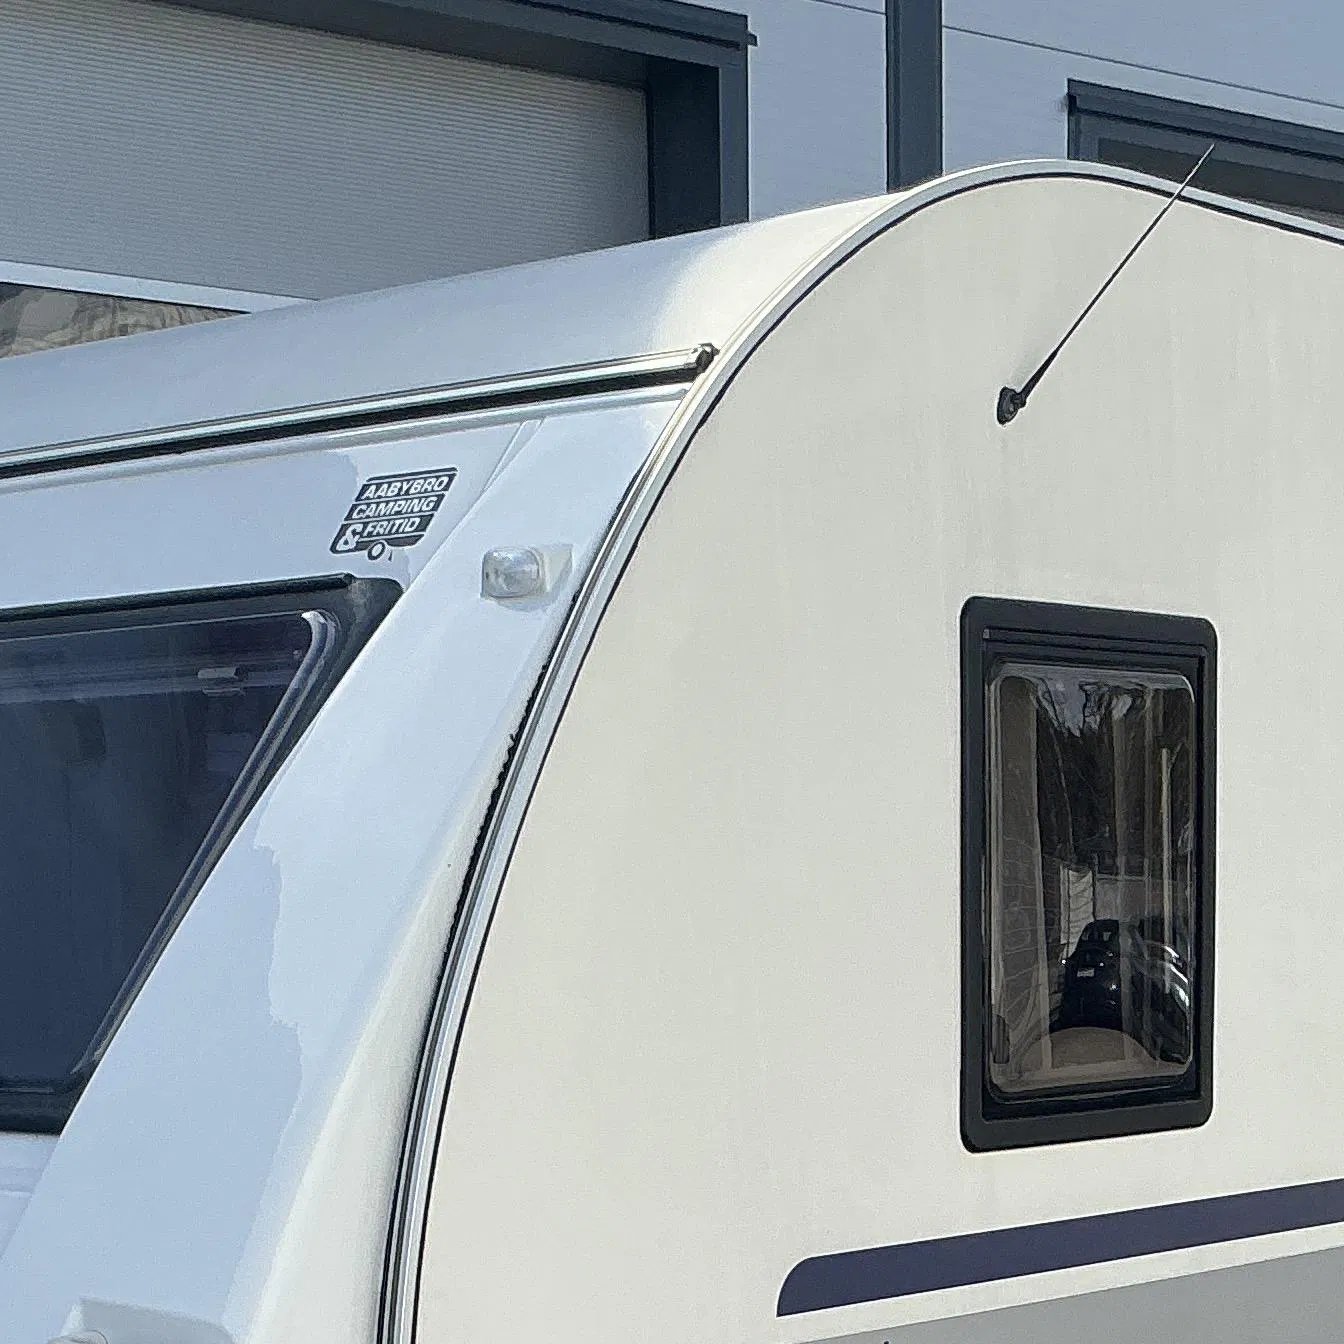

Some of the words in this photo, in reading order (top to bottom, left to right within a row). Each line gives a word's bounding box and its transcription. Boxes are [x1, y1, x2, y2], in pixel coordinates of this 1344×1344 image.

[361, 476, 449, 500] AABYBRO
[351, 497, 437, 519] CAMPING
[336, 524, 363, 551] &
[364, 517, 420, 537] FRITID
